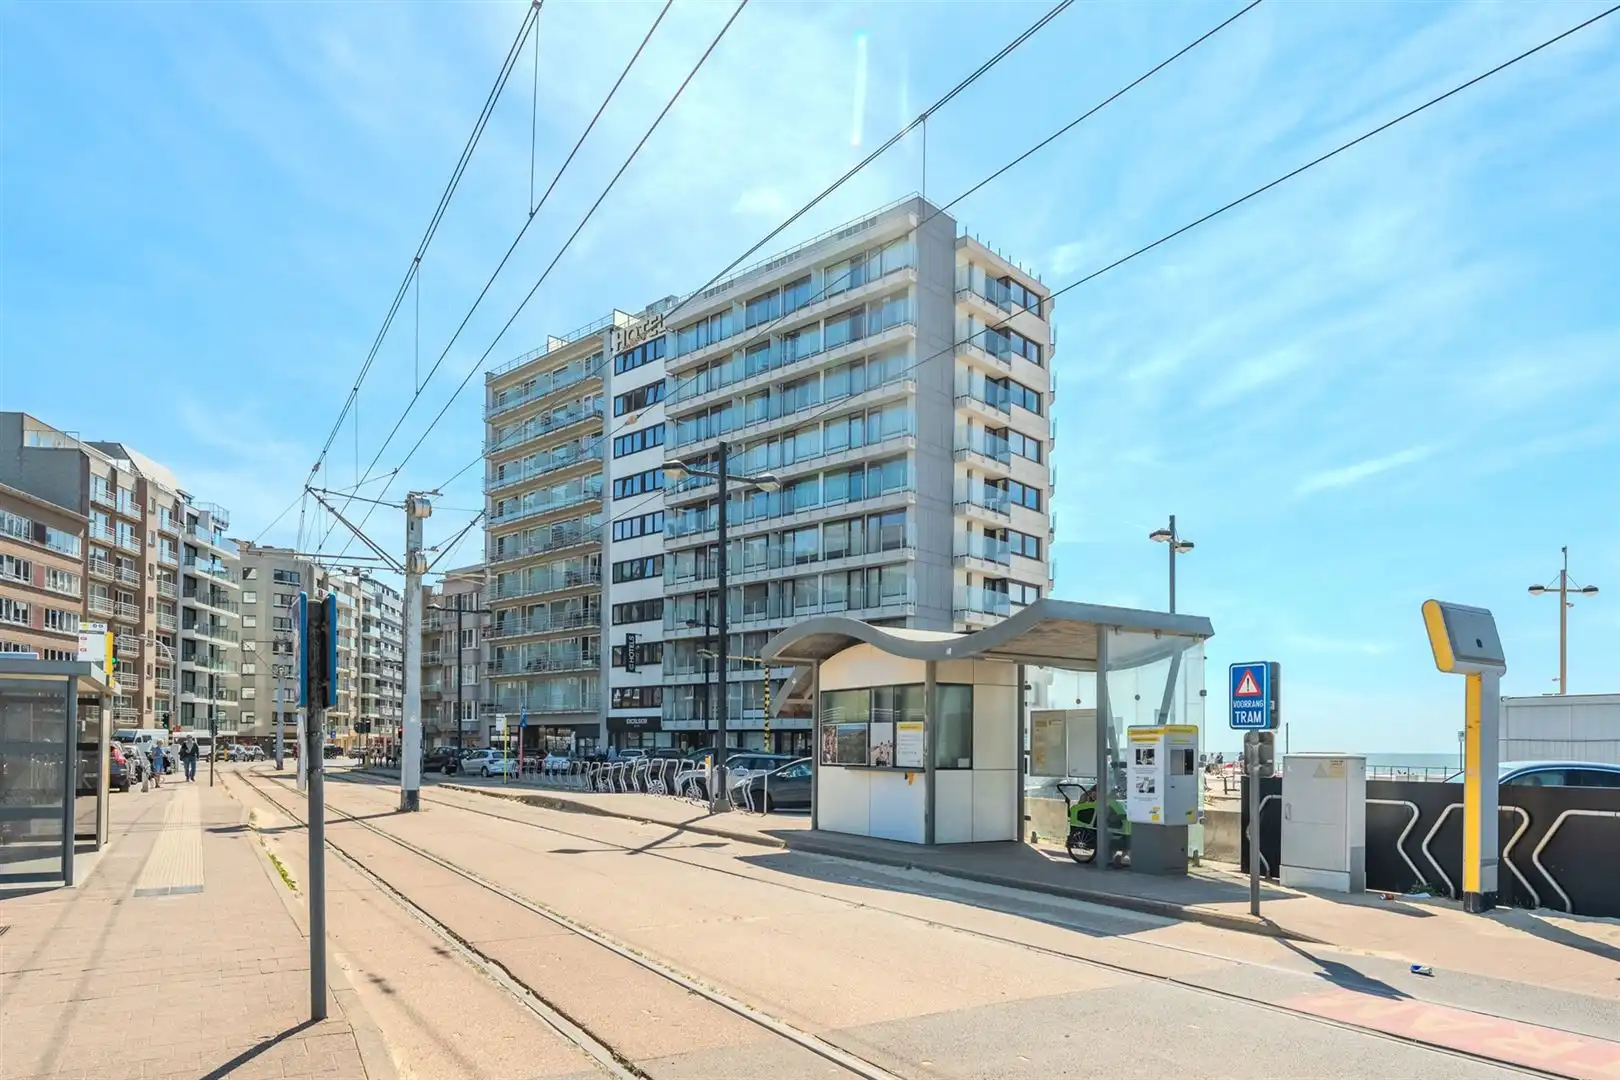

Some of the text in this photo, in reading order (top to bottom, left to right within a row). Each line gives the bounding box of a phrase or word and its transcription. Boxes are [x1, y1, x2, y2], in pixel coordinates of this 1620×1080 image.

[616, 313, 666, 351] HOTEL
[1233, 700, 1264, 708] VOORRANG
[1235, 711, 1262, 724] TRAM
